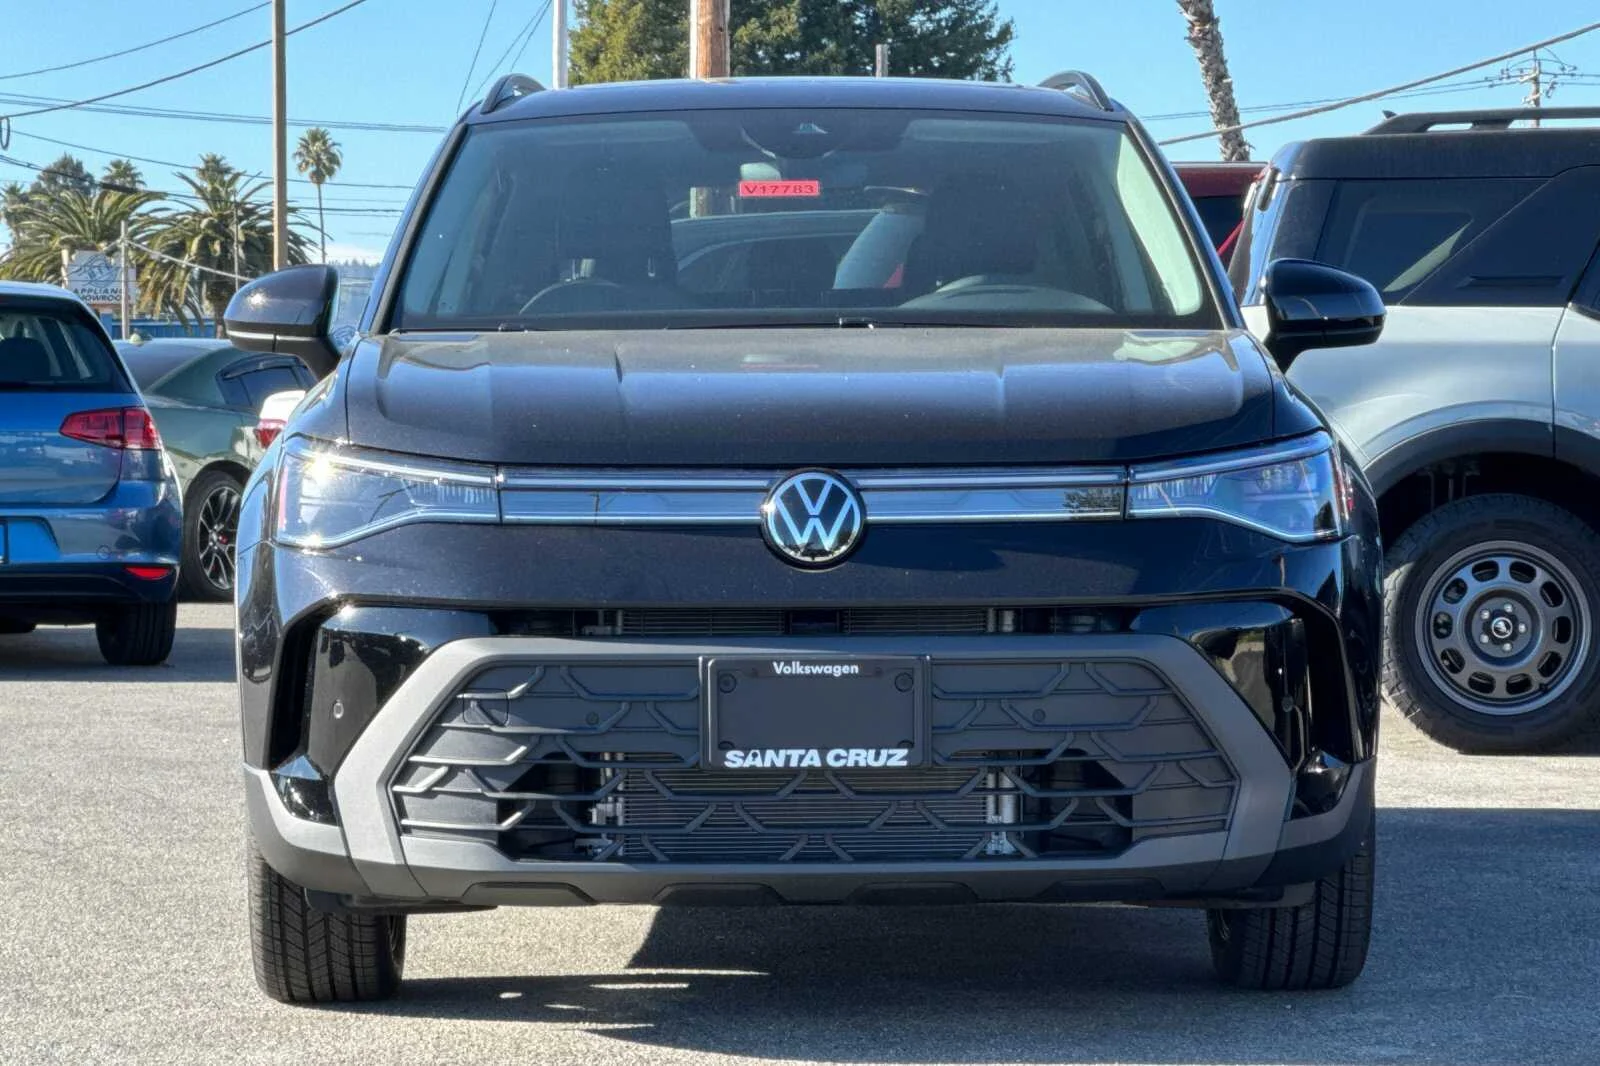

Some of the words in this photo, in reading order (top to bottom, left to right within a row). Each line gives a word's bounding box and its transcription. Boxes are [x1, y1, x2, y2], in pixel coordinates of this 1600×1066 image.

[743, 184, 814, 194] V17783
[772, 661, 860, 677] Volkswagen
[723, 748, 822, 769] SANTA
[826, 748, 909, 767] CRUZ
